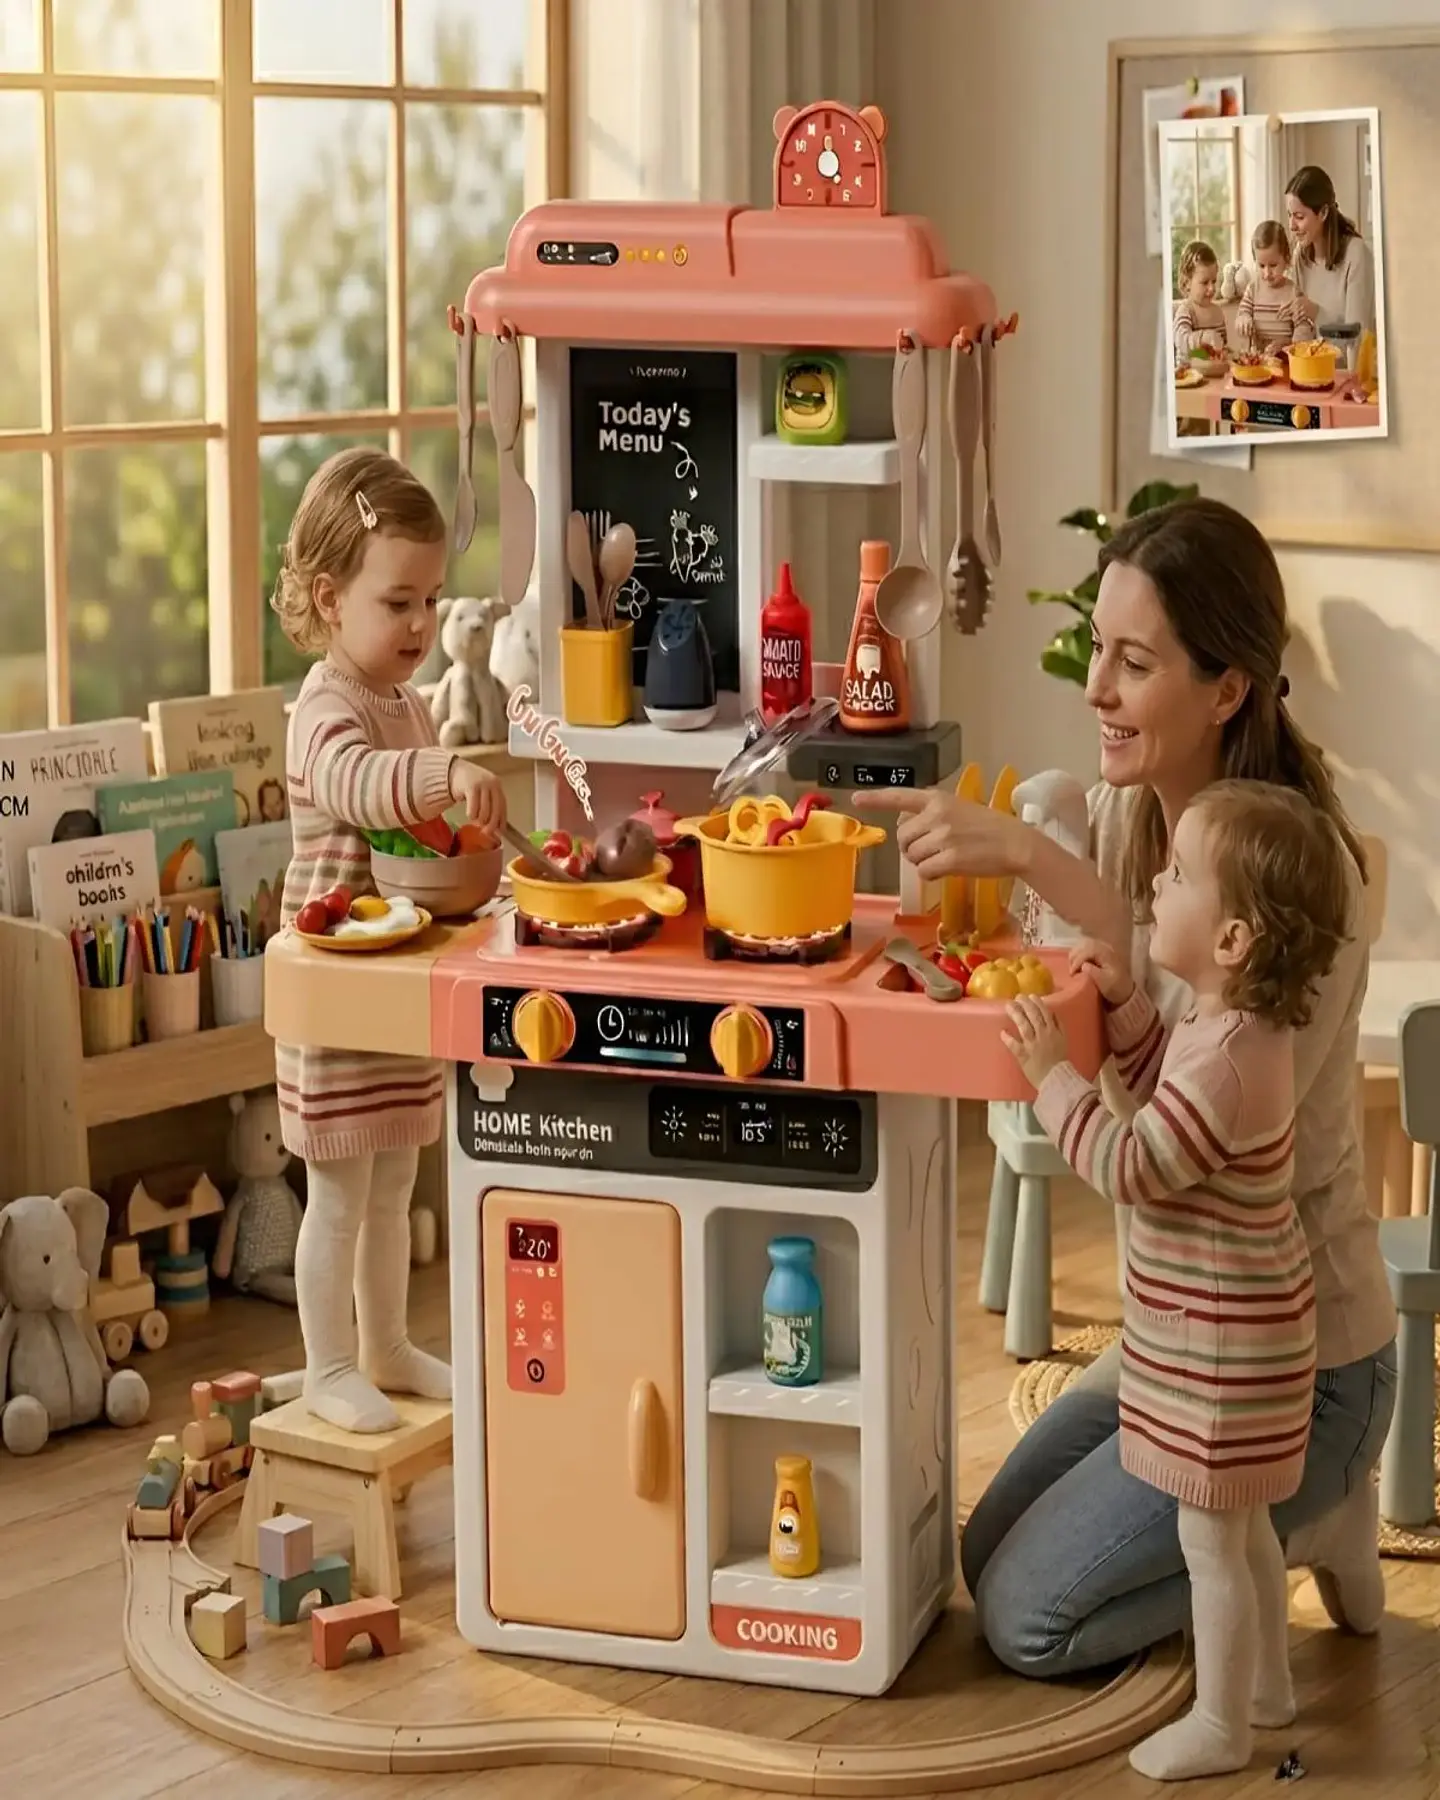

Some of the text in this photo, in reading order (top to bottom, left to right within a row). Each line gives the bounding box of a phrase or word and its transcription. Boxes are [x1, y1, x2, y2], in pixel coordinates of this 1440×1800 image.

[598, 400, 692, 432] Today's
[598, 428, 664, 453] Menu
[845, 678, 893, 700] SALAD
[473, 1110, 613, 1143] HOME Kitchen
[736, 1617, 839, 1651] COOKING
